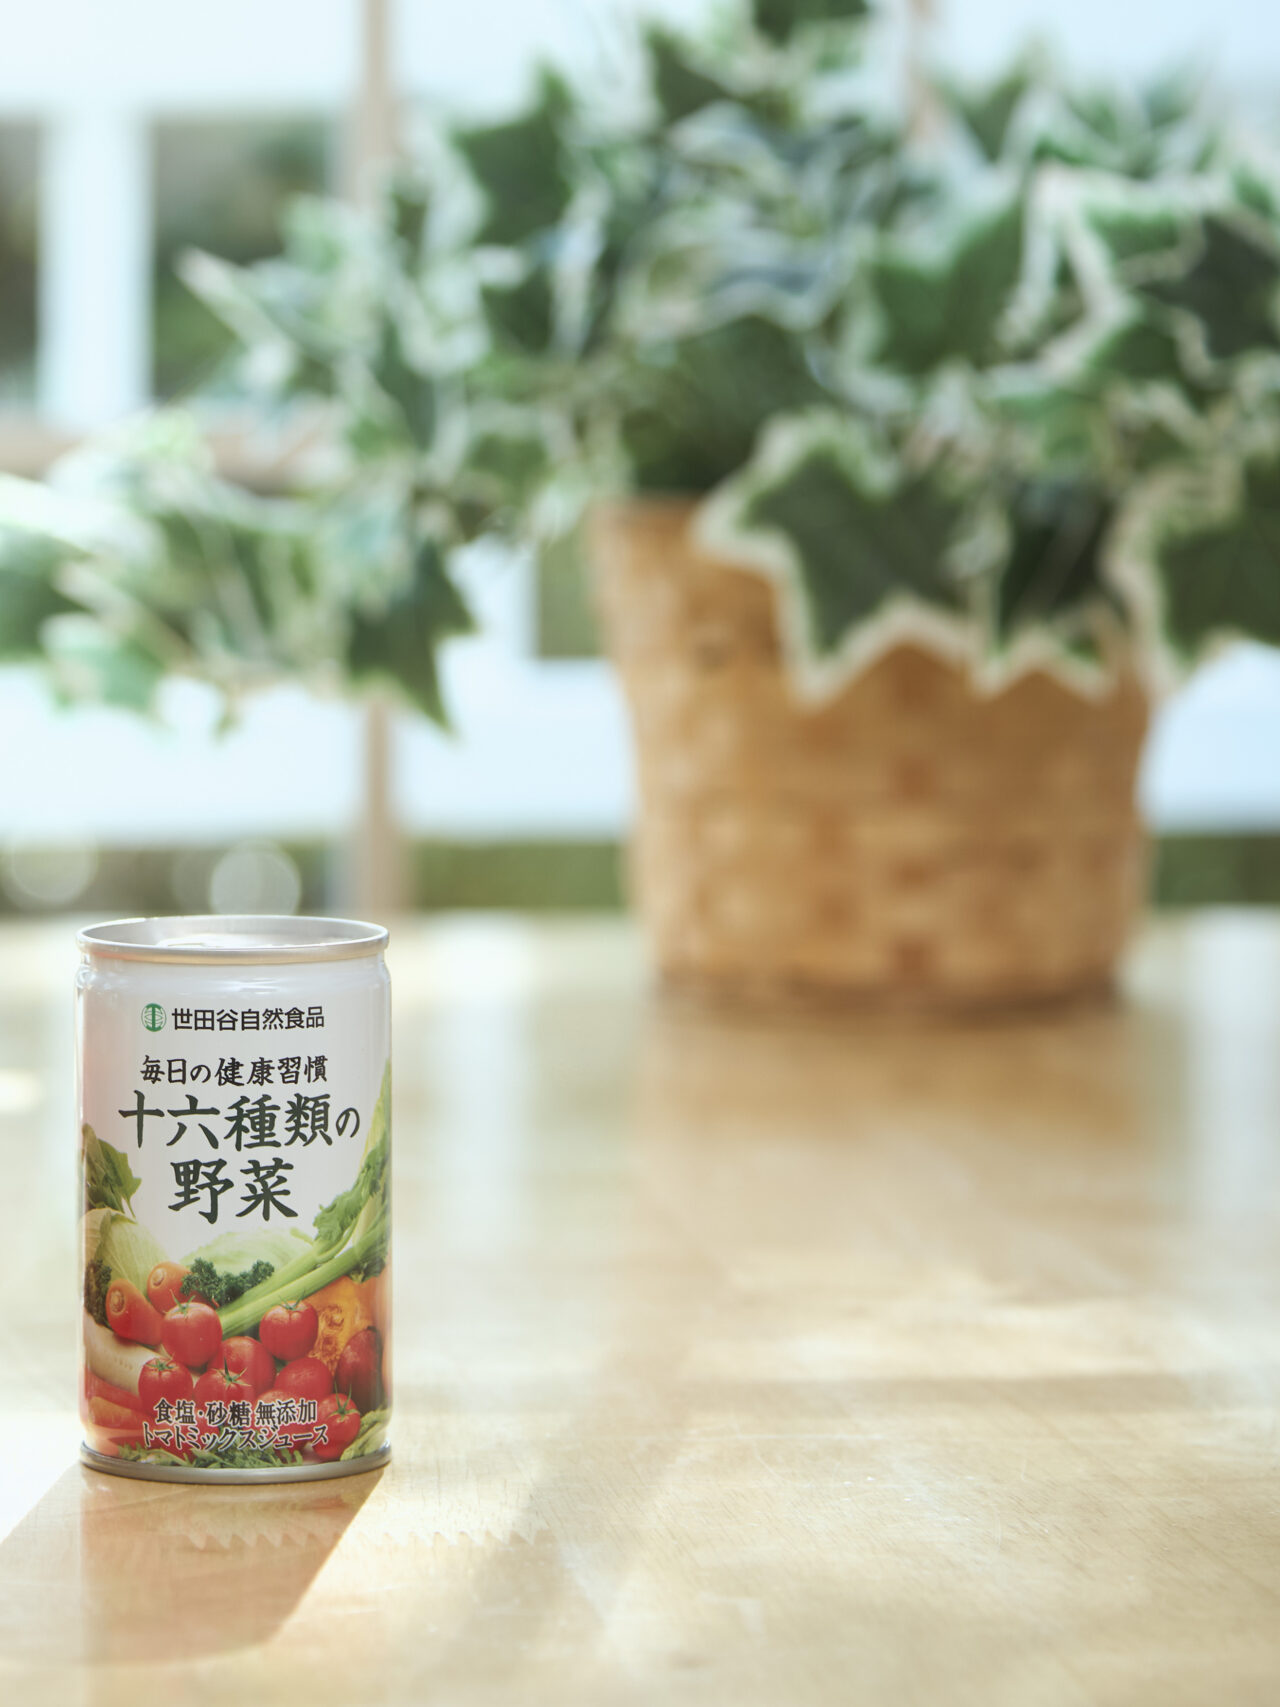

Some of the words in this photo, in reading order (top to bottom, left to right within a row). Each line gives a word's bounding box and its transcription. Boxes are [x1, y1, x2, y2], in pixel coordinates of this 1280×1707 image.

[171, 1006, 325, 1031] 世田谷自然食品
[139, 1055, 328, 1086] 毎日の健康習慣
[118, 1089, 360, 1152] 十六種類の
[168, 1157, 298, 1224] 野菜
[142, 1422, 329, 1451] トマトミックスジュース
